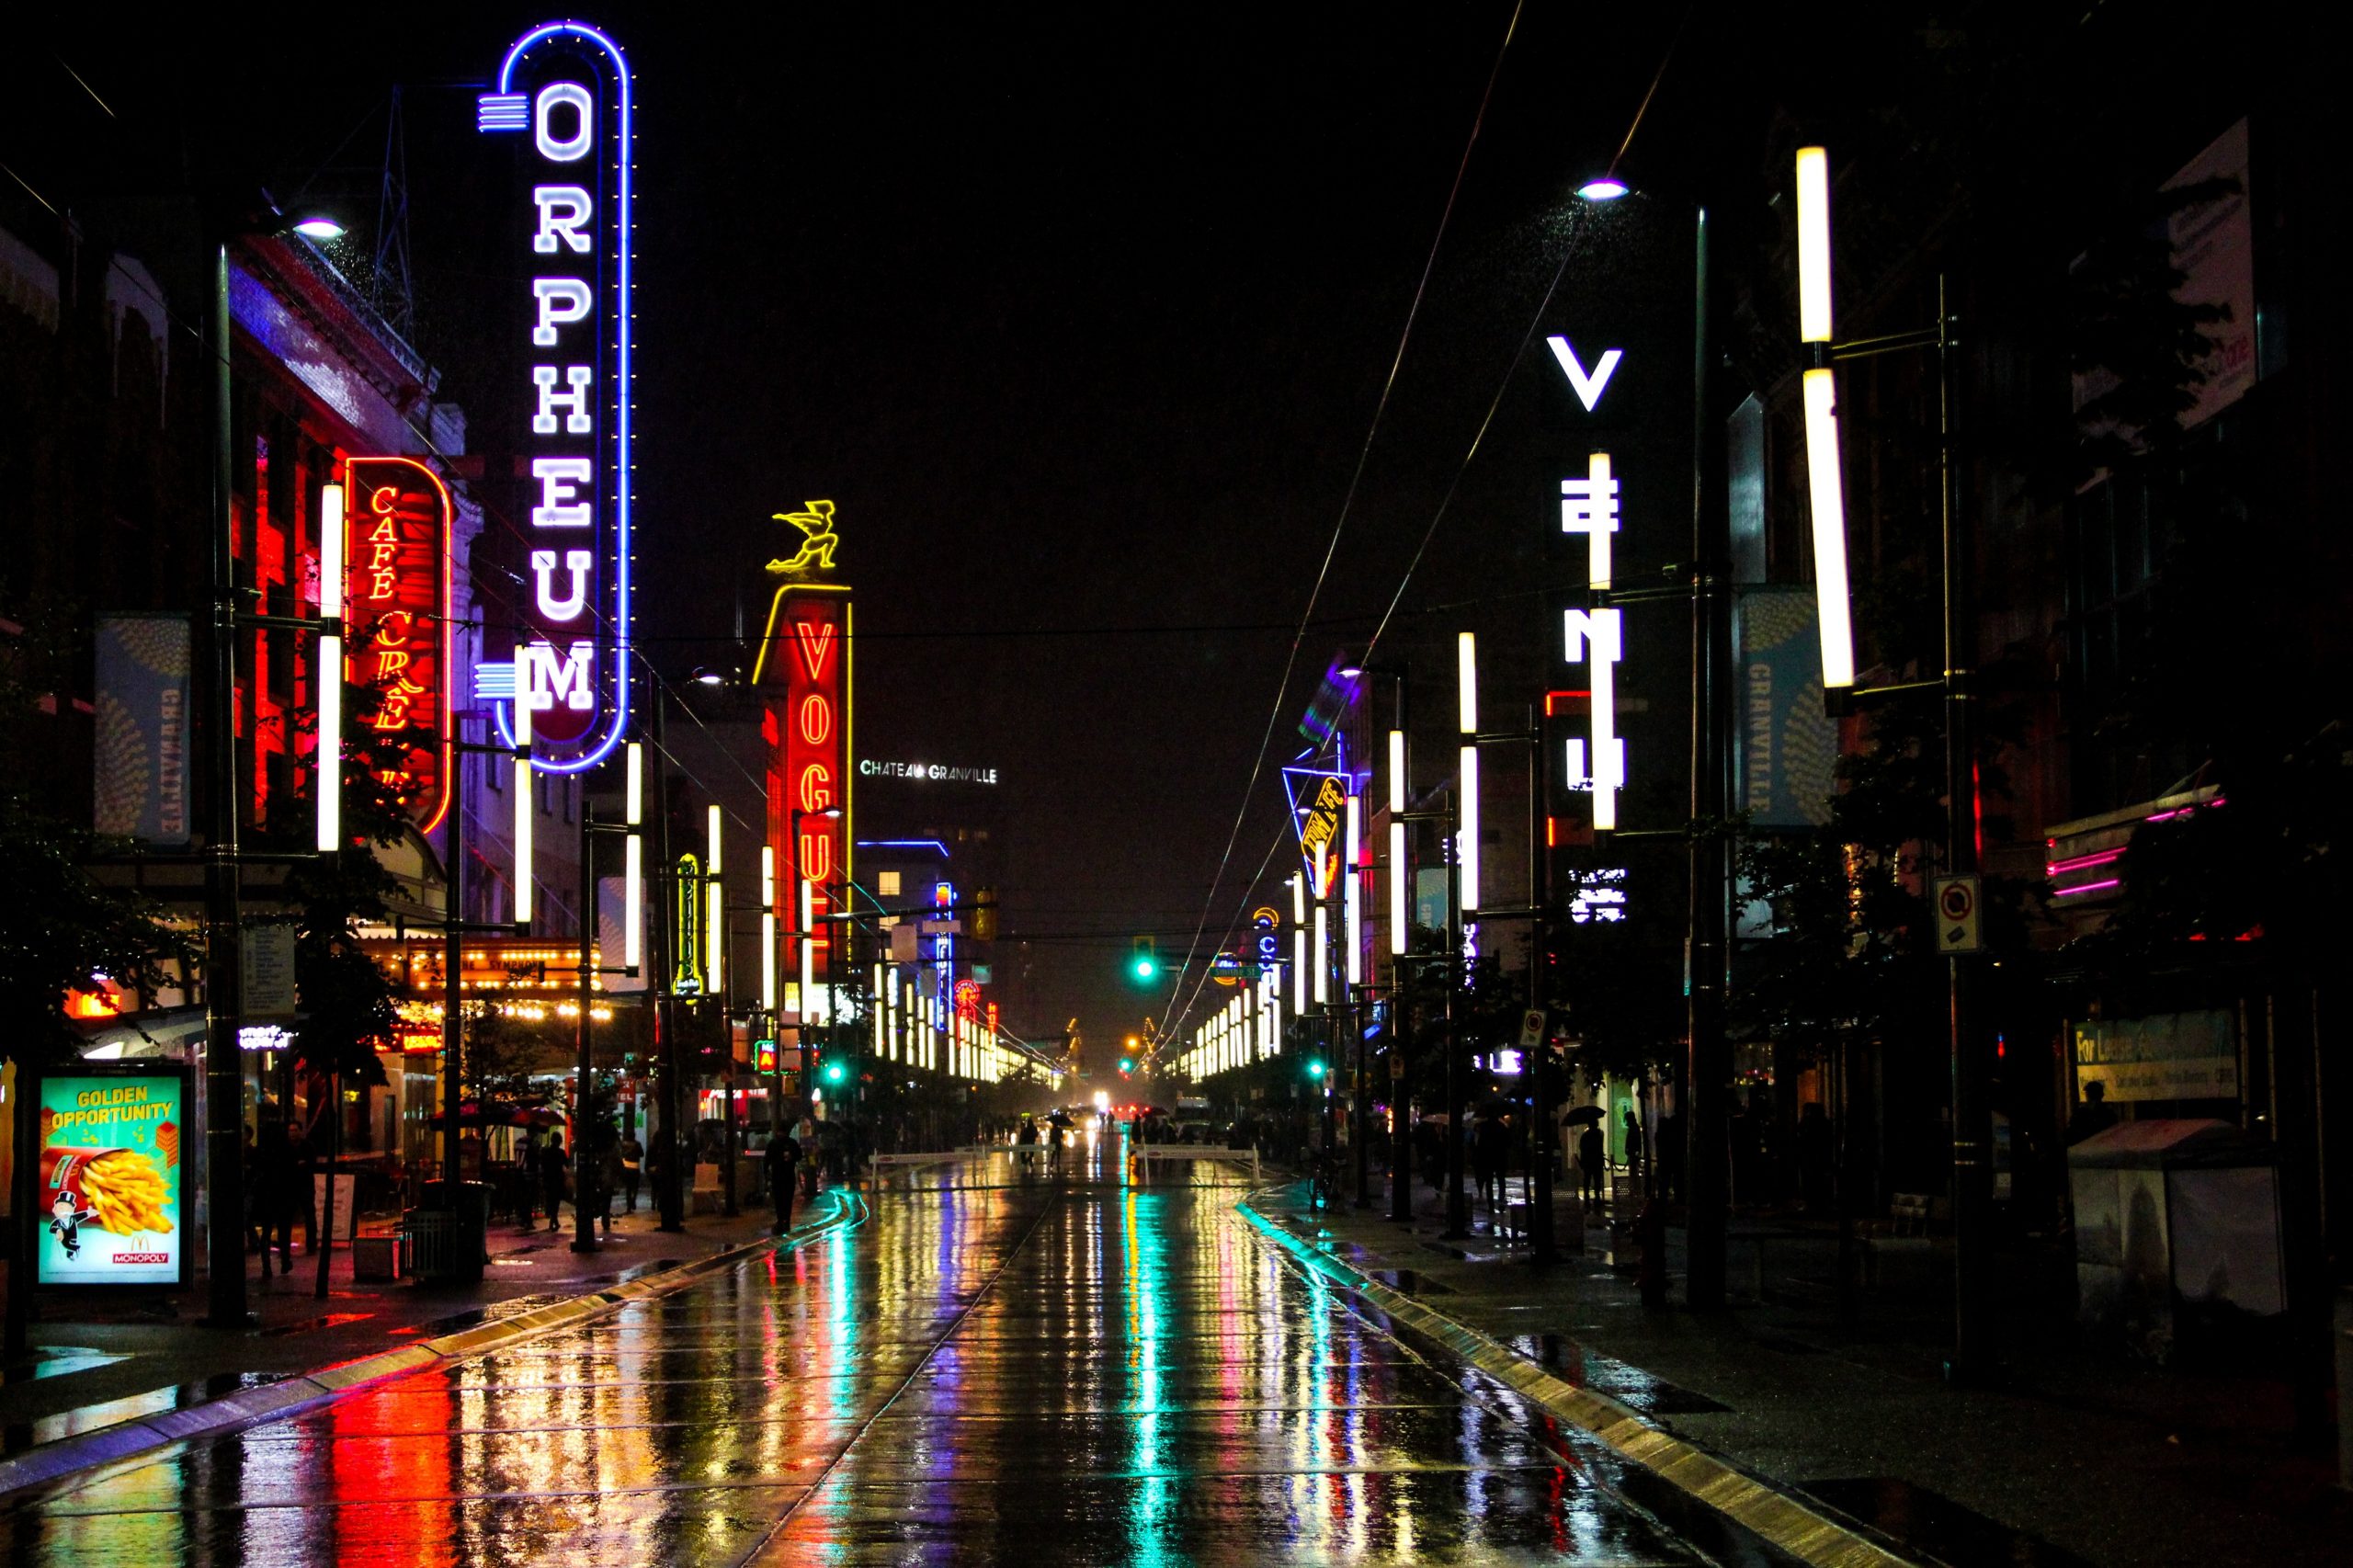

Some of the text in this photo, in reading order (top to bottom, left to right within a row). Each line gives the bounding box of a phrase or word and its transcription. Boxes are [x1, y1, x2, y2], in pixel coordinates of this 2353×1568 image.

[531, 80, 594, 710] ORPHEUM
[368, 486, 426, 805] CAFÉ CRÊ
[160, 687, 184, 834] GRANVILLE
[859, 759, 997, 784] CHATEAU GRANVILLE
[1214, 968, 1244, 976] Smithe
[2075, 1028, 2096, 1063] For
[77, 1085, 148, 1108] GOLDEN
[51, 1101, 174, 1130] OPPORTUNITY
[114, 1254, 166, 1263] MONOPOLY
